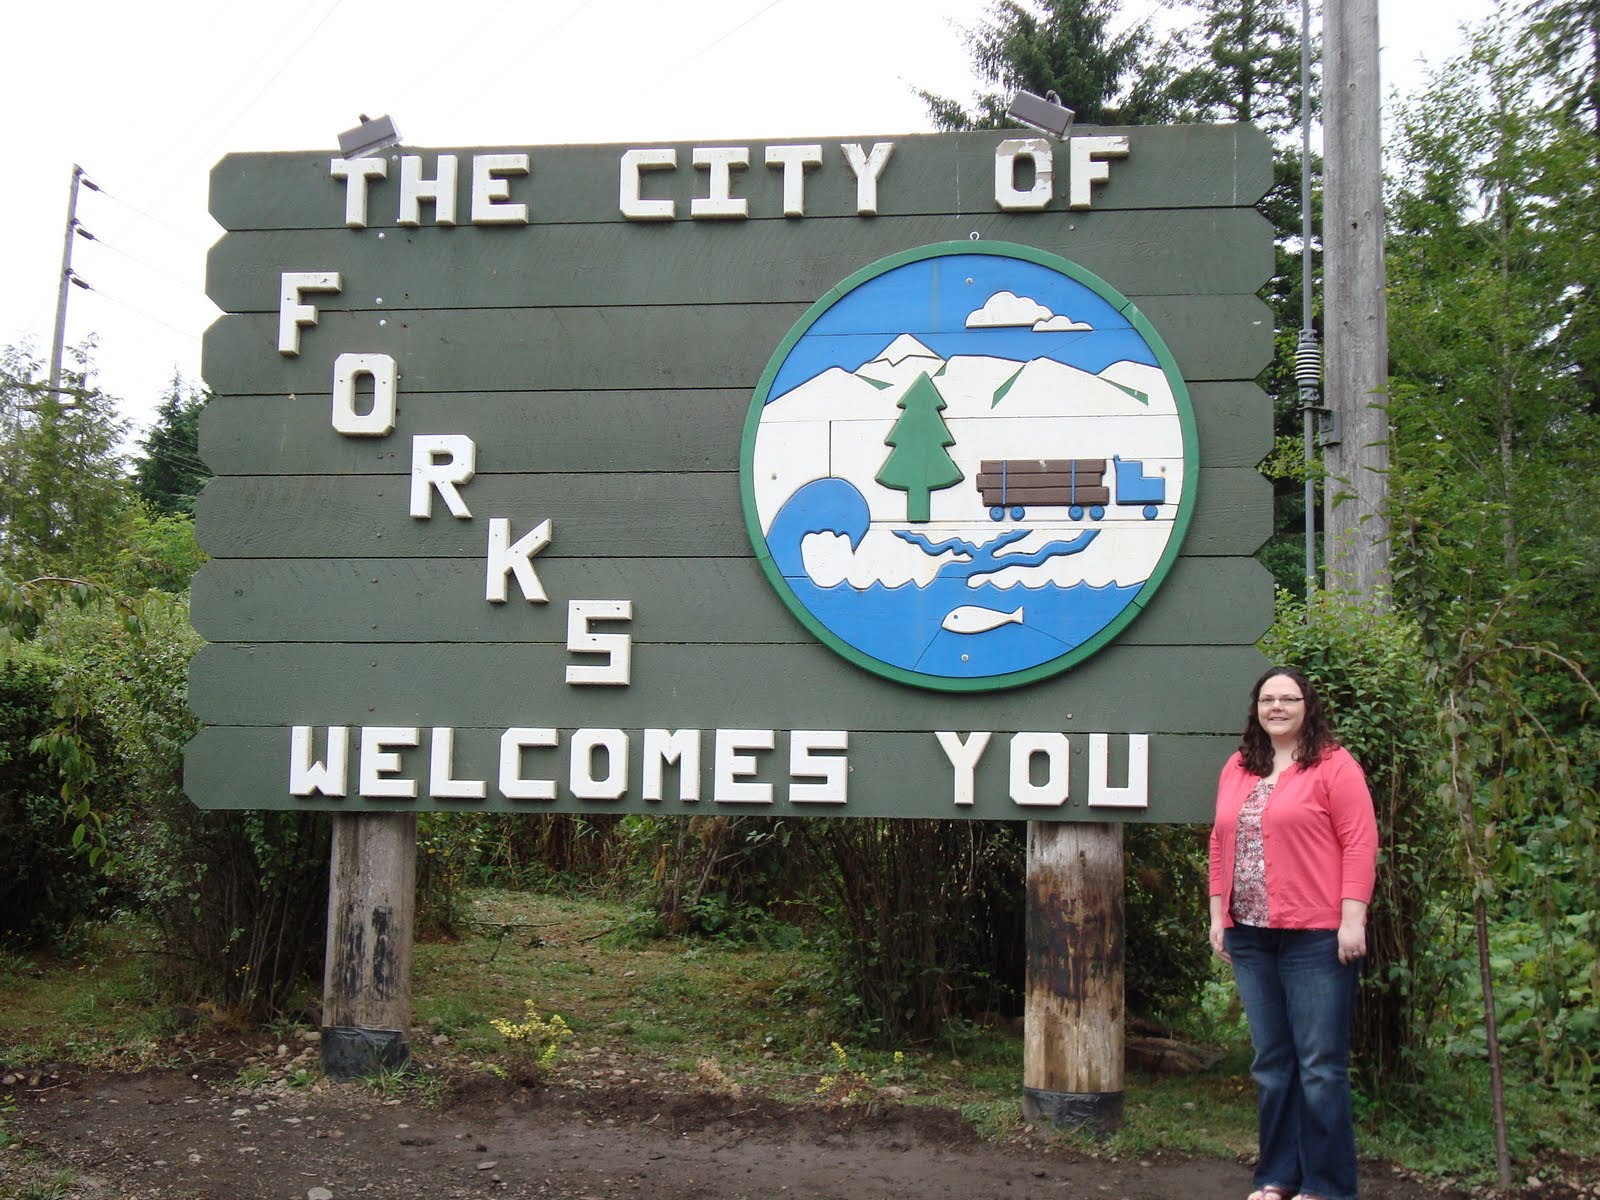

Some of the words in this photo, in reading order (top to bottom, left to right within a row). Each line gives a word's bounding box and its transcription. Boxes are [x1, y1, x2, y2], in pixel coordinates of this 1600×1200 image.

[329, 152, 531, 228] THE
[619, 141, 894, 220] CITY
[994, 135, 1130, 212] OF
[278, 271, 634, 688] FORKS
[289, 725, 849, 804] WELCOMES
[935, 731, 1150, 808] YOU
